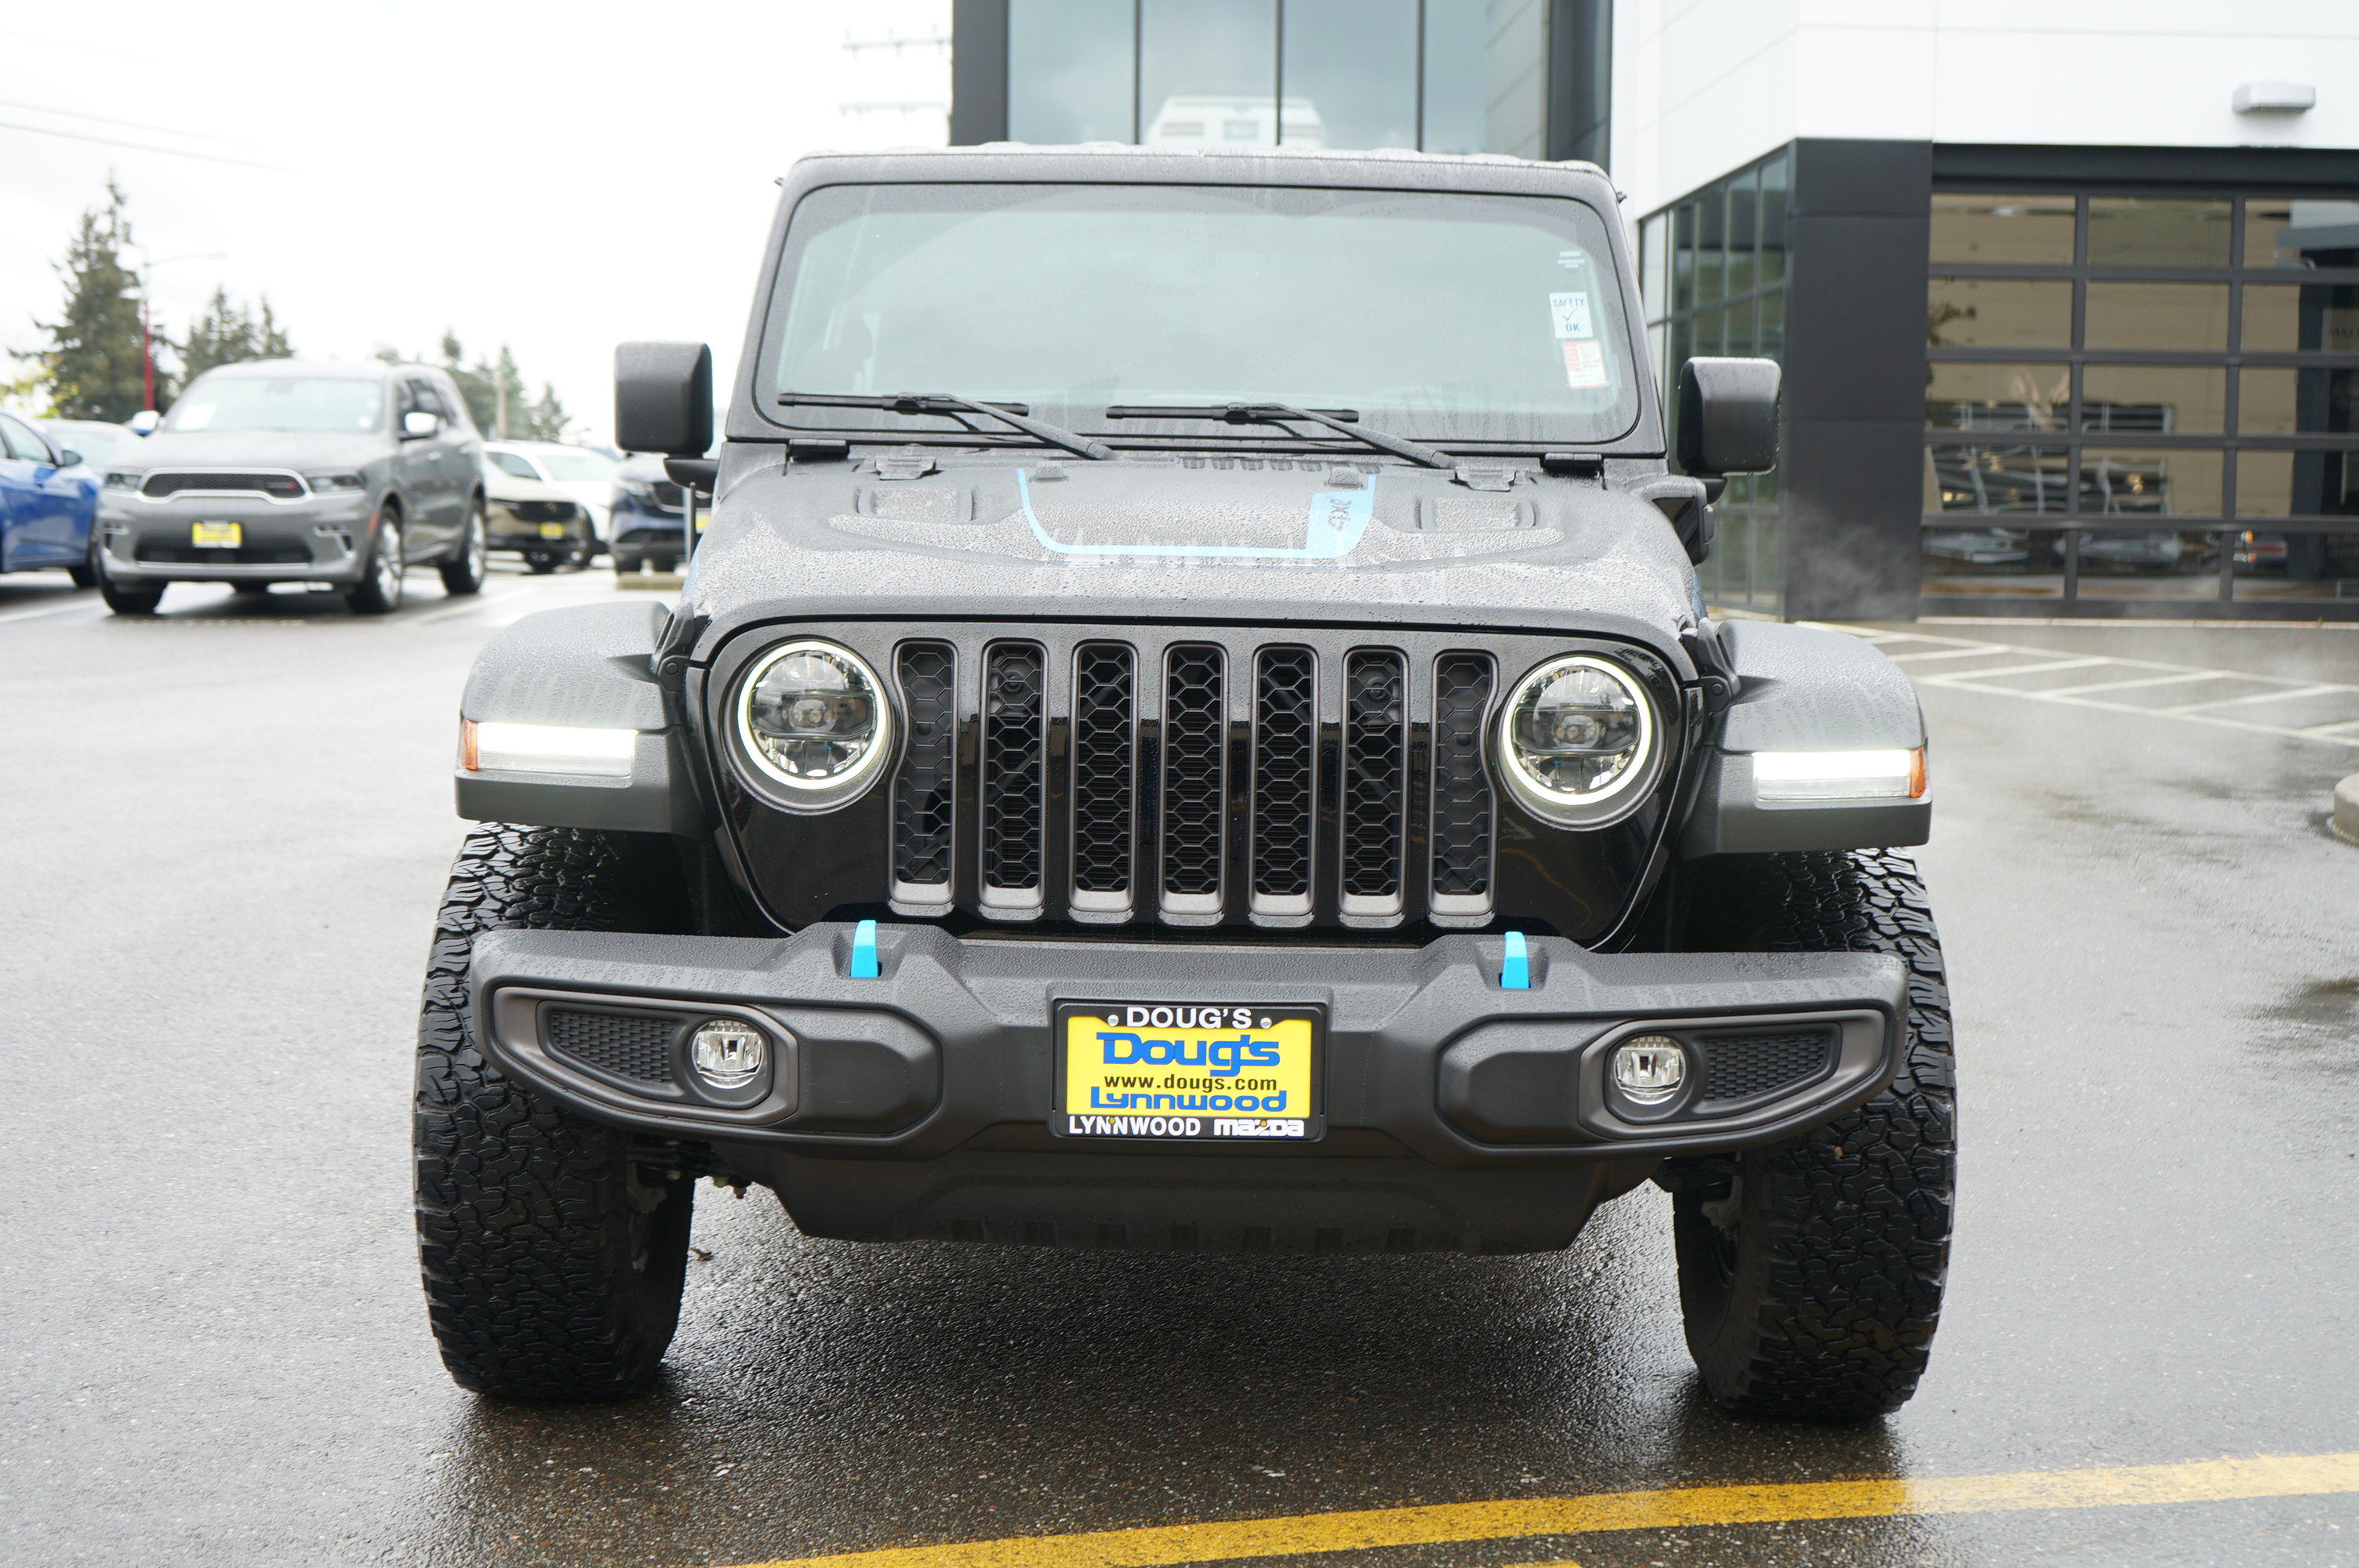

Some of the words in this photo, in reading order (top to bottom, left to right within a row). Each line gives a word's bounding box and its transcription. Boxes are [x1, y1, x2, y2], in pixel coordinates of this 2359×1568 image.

[1553, 299, 1584, 307] SAFETY
[1127, 1007, 1252, 1029] DOUG'S
[1096, 1032, 1280, 1076] Doug's
[1104, 1074, 1278, 1093] www.dougs.com
[1091, 1087, 1287, 1112] Lynnwood
[1069, 1116, 1201, 1136] LYNNWOOD
